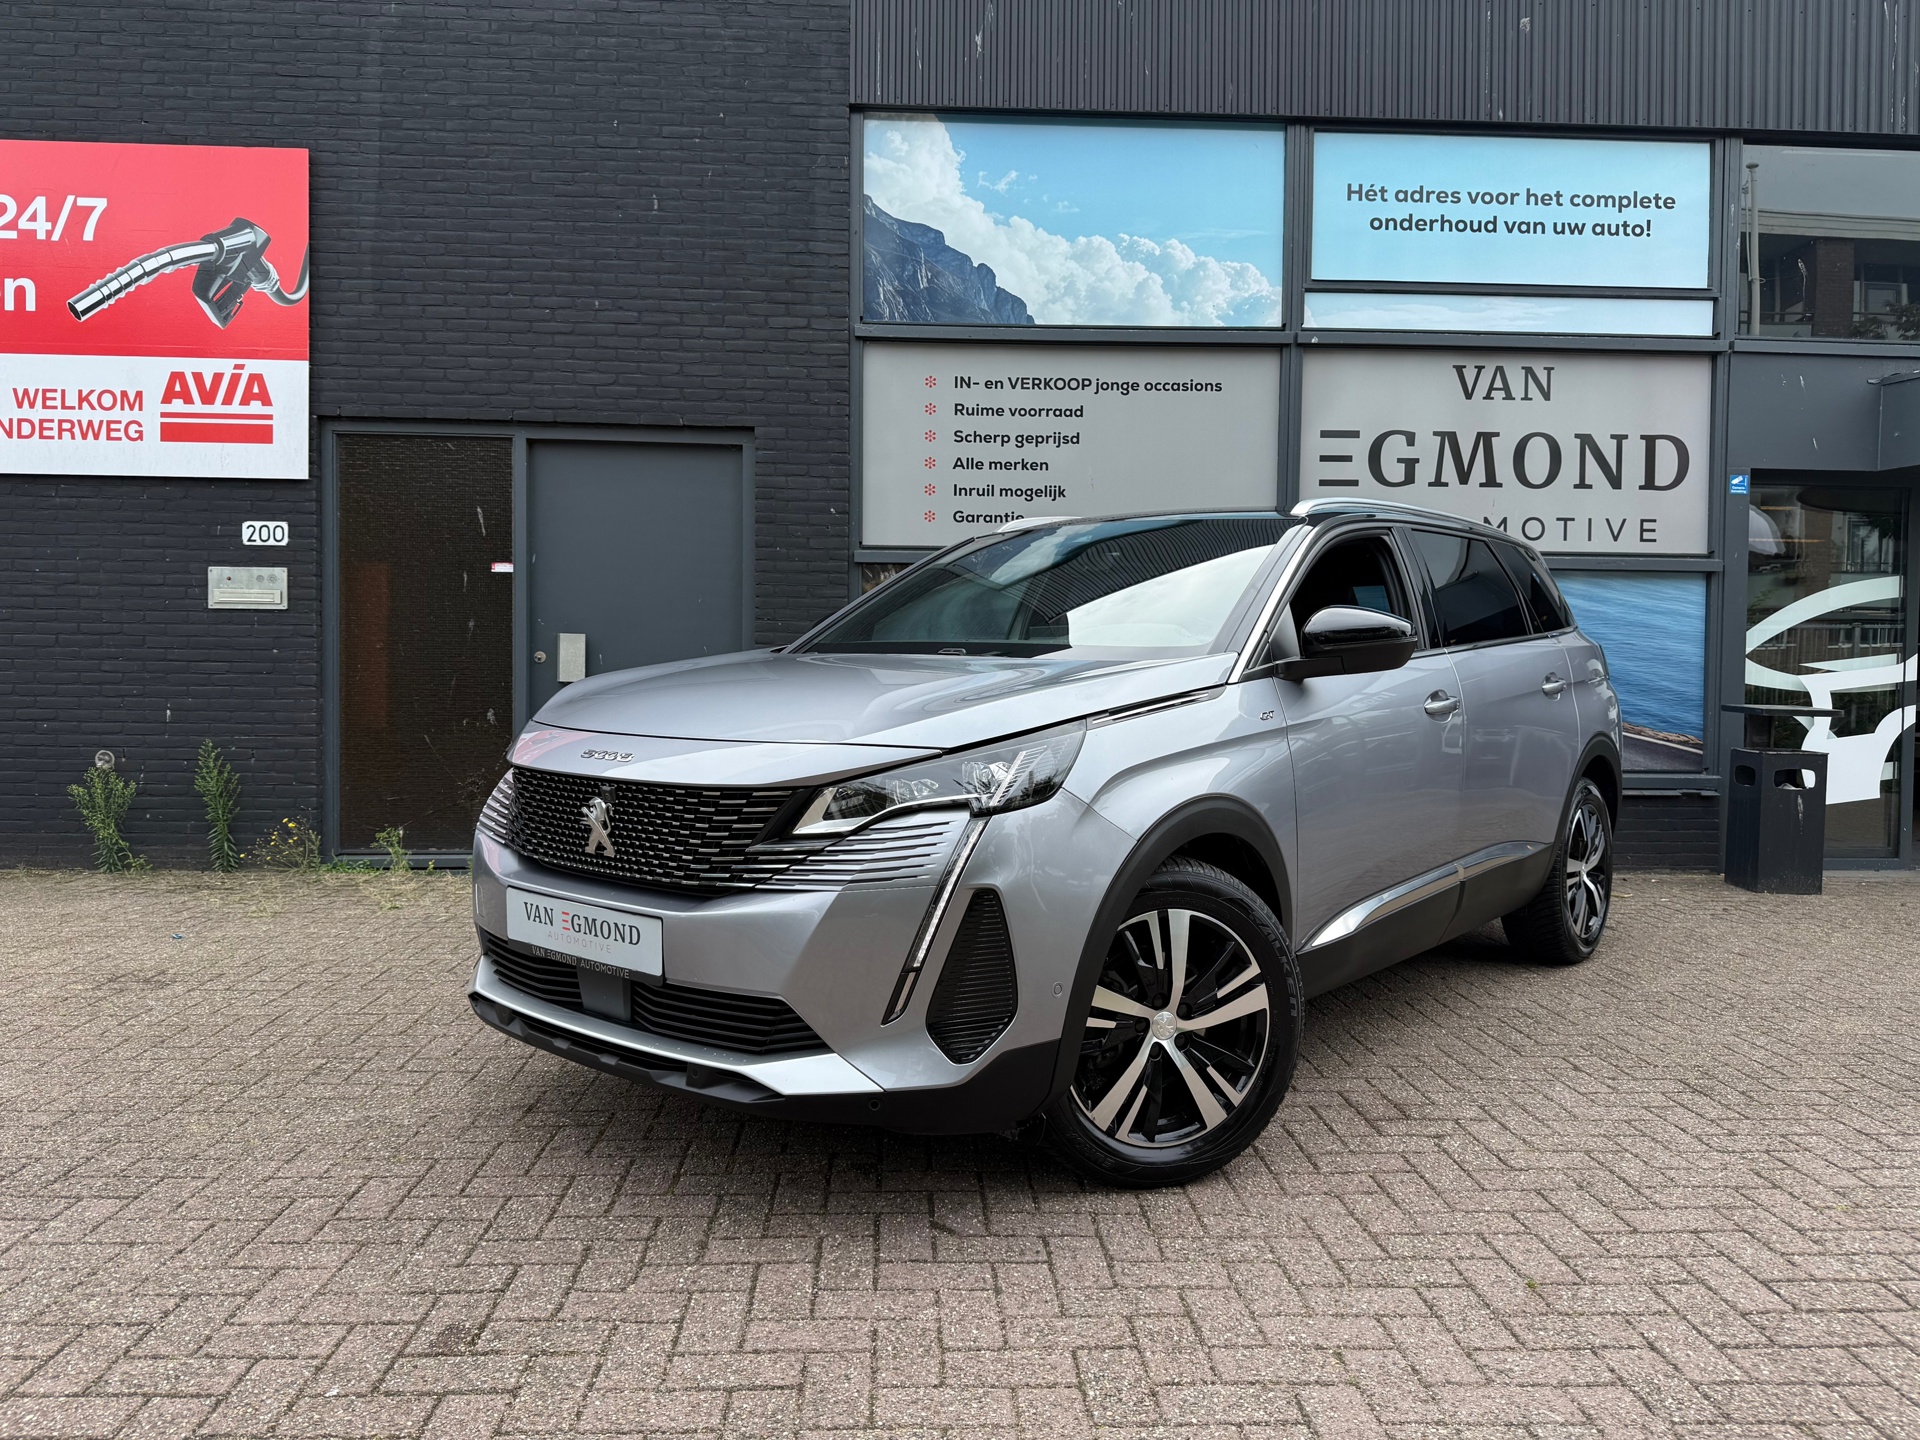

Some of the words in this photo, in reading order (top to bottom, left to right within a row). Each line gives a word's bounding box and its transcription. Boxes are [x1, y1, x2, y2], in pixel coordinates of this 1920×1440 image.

[1347, 183, 1388, 202] Hét
[1394, 185, 1461, 204] adres
[1467, 191, 1520, 205] voor
[1526, 187, 1564, 207] het
[1569, 191, 1676, 213] complete
[0, 194, 107, 241] 24/7
[1369, 213, 1498, 233] onderhoud
[1503, 220, 1546, 235] van
[1553, 221, 1586, 236] uw
[1591, 219, 1652, 238] auto!
[954, 376, 980, 390] IN-
[984, 379, 1004, 390] en
[1007, 377, 1092, 391] VERKOOP
[1094, 378, 1140, 396] jonge
[1144, 379, 1223, 392] occasions
[1453, 364, 1555, 402] VAN
[12, 388, 143, 412] WELKOM
[954, 403, 1005, 417] Ruime
[1008, 405, 1084, 418] voorraad
[953, 430, 1011, 447] Scherp
[1015, 431, 1081, 449] geprijsd
[952, 457, 984, 470] Alle
[988, 458, 1049, 471] merken
[1319, 430, 1690, 491] EGMOND
[953, 484, 995, 497] Inruil
[999, 485, 1067, 502] mogelijk
[246, 525, 285, 543] 200
[523, 902, 554, 927] VAN
[561, 911, 641, 946] EGMOND
[547, 931, 612, 953] AUTOMOTIVE
[532, 946, 546, 957] VAN
[580, 960, 630, 979] AUTOMOTIVE
